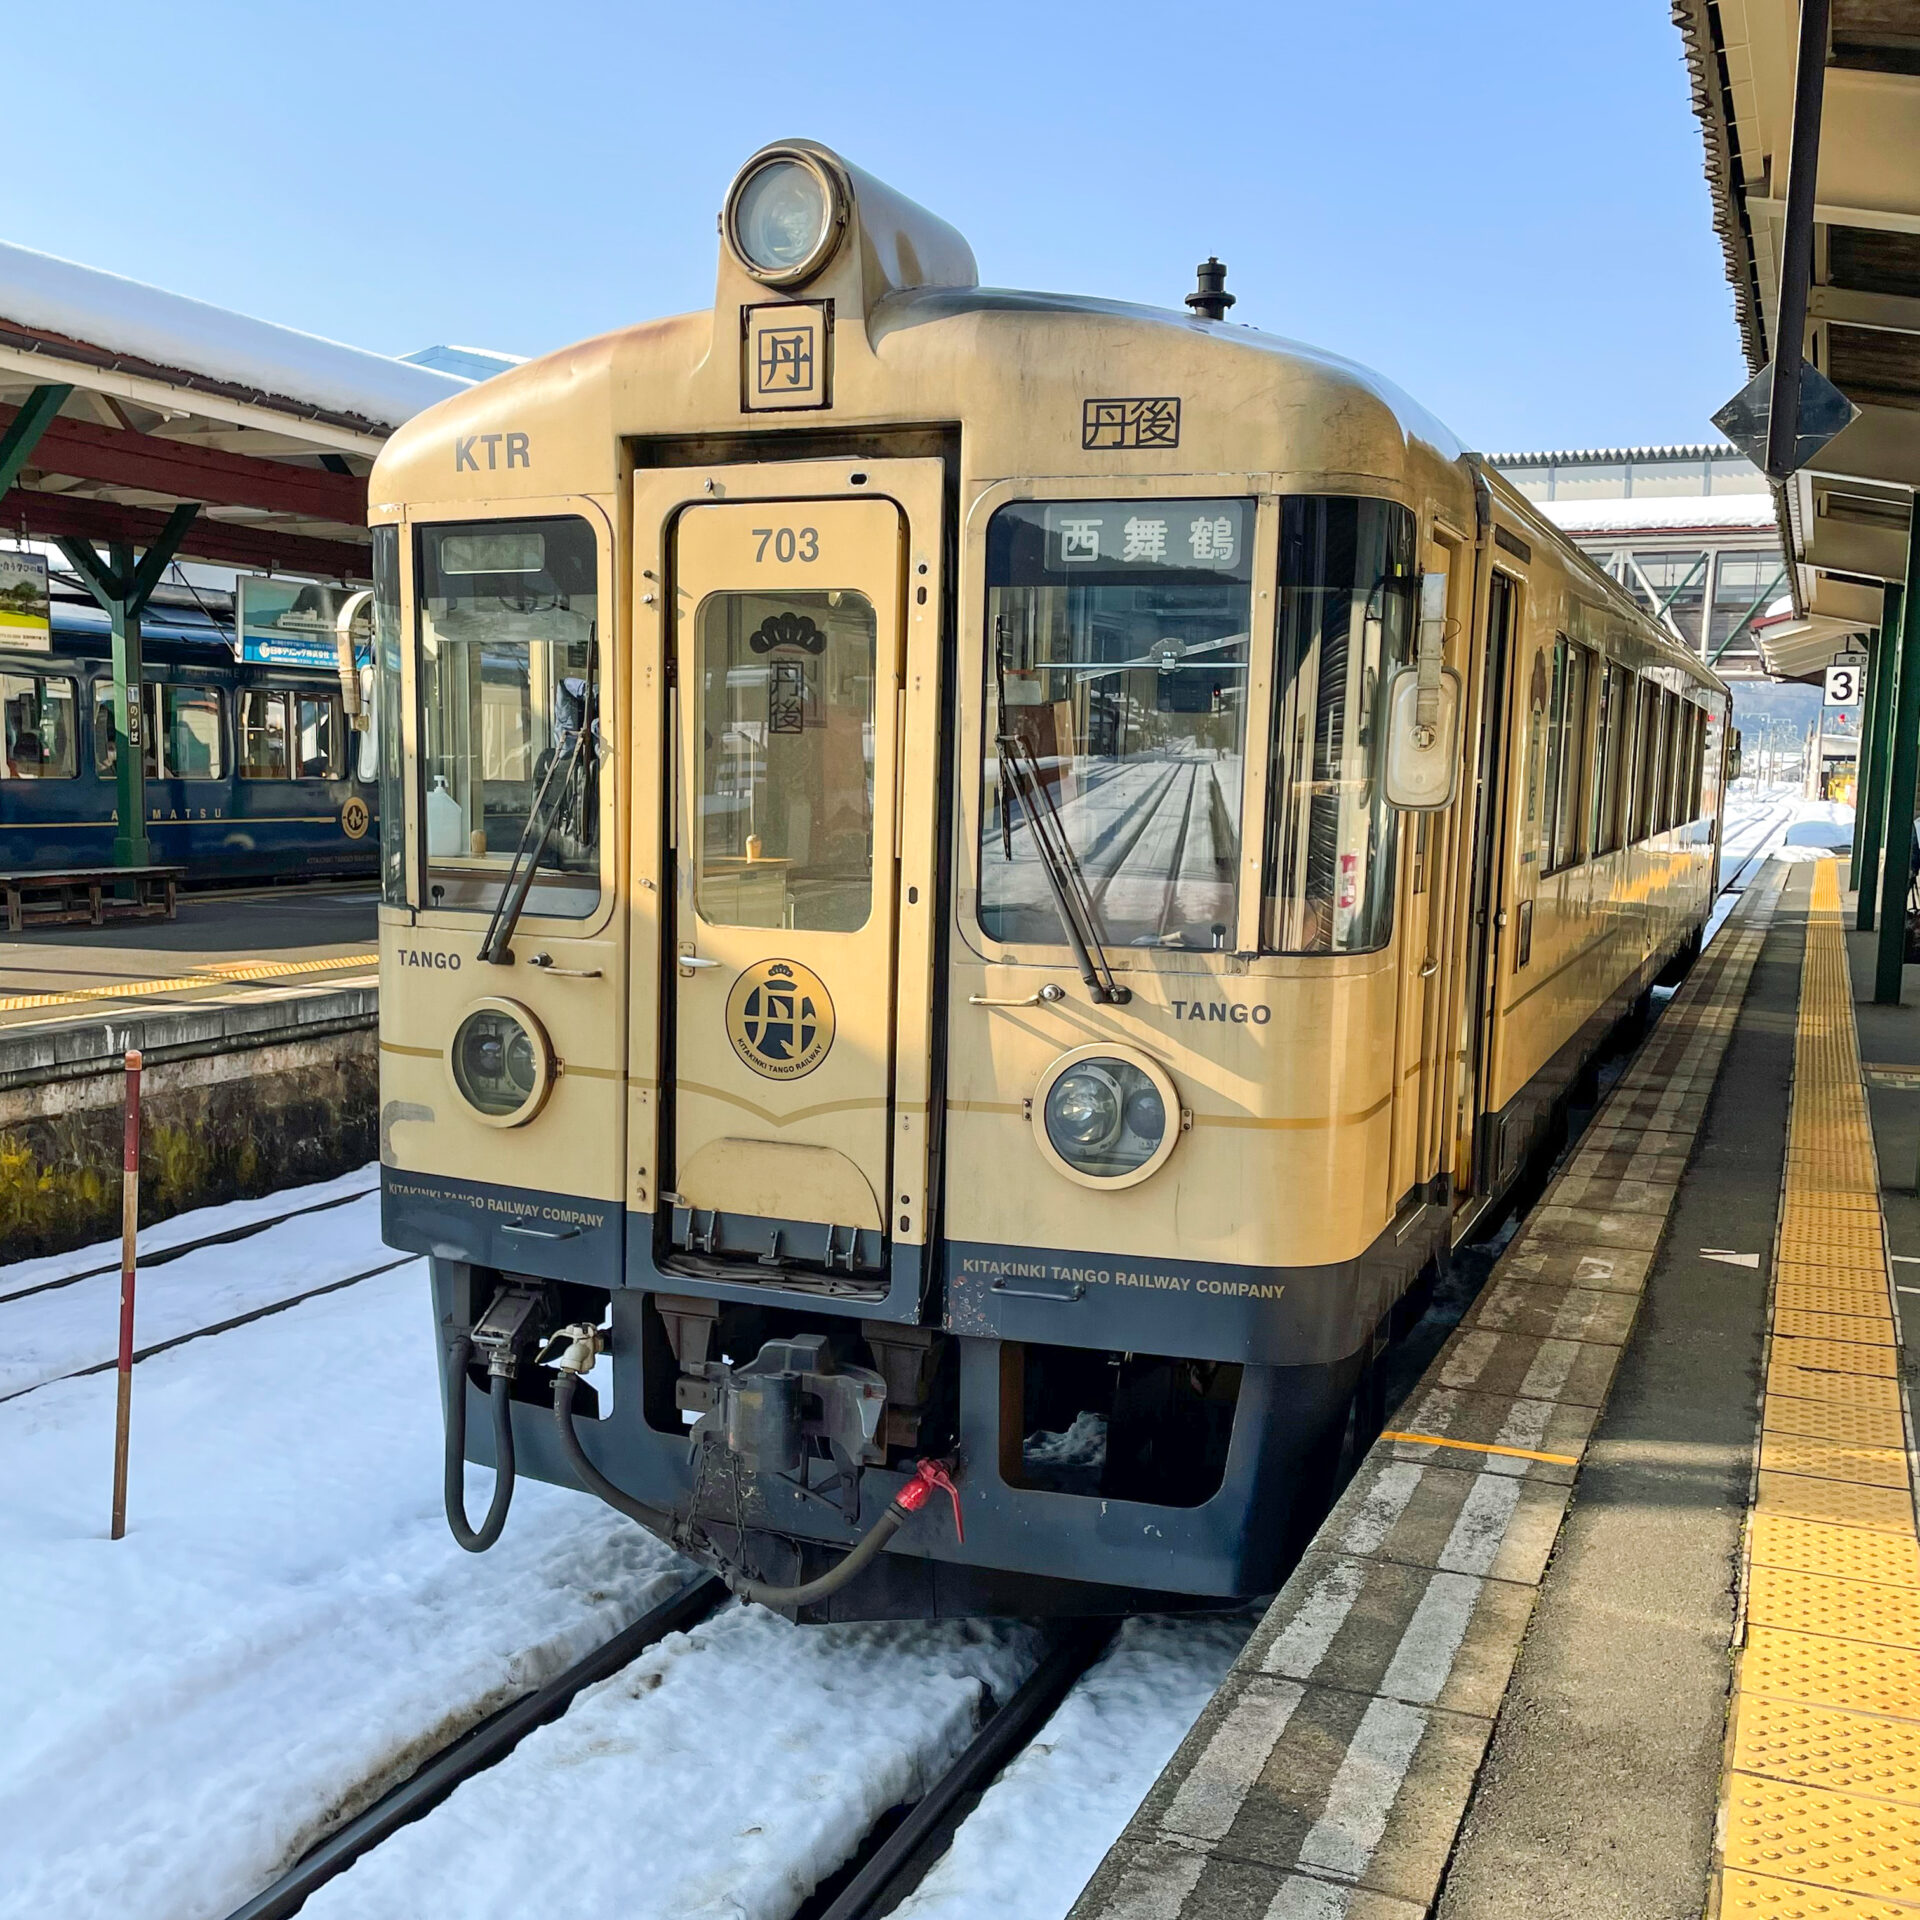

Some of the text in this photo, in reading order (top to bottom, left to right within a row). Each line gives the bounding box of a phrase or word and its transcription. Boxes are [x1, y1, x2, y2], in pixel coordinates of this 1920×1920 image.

[759, 331, 812, 388] 丹
[1083, 398, 1179, 449] 丹後
[455, 432, 530, 472] KTR
[752, 527, 819, 562] 703
[1060, 516, 1234, 562] 西舞鶴
[769, 661, 803, 734] 丹後
[1831, 672, 1853, 701] 3
[130, 705, 138, 742] のりば
[111, 808, 222, 821] AMATSU
[398, 949, 461, 970] TANGO
[1171, 1001, 1271, 1025] TANGO
[738, 1038, 823, 1073] KITAKINKI TANGO RAILWAY
[487, 1199, 539, 1217] RAILWAY
[542, 1207, 604, 1227] COMPANY
[963, 1258, 1286, 1299] KITAKINKI TANGO RAILWAY COMPANY
